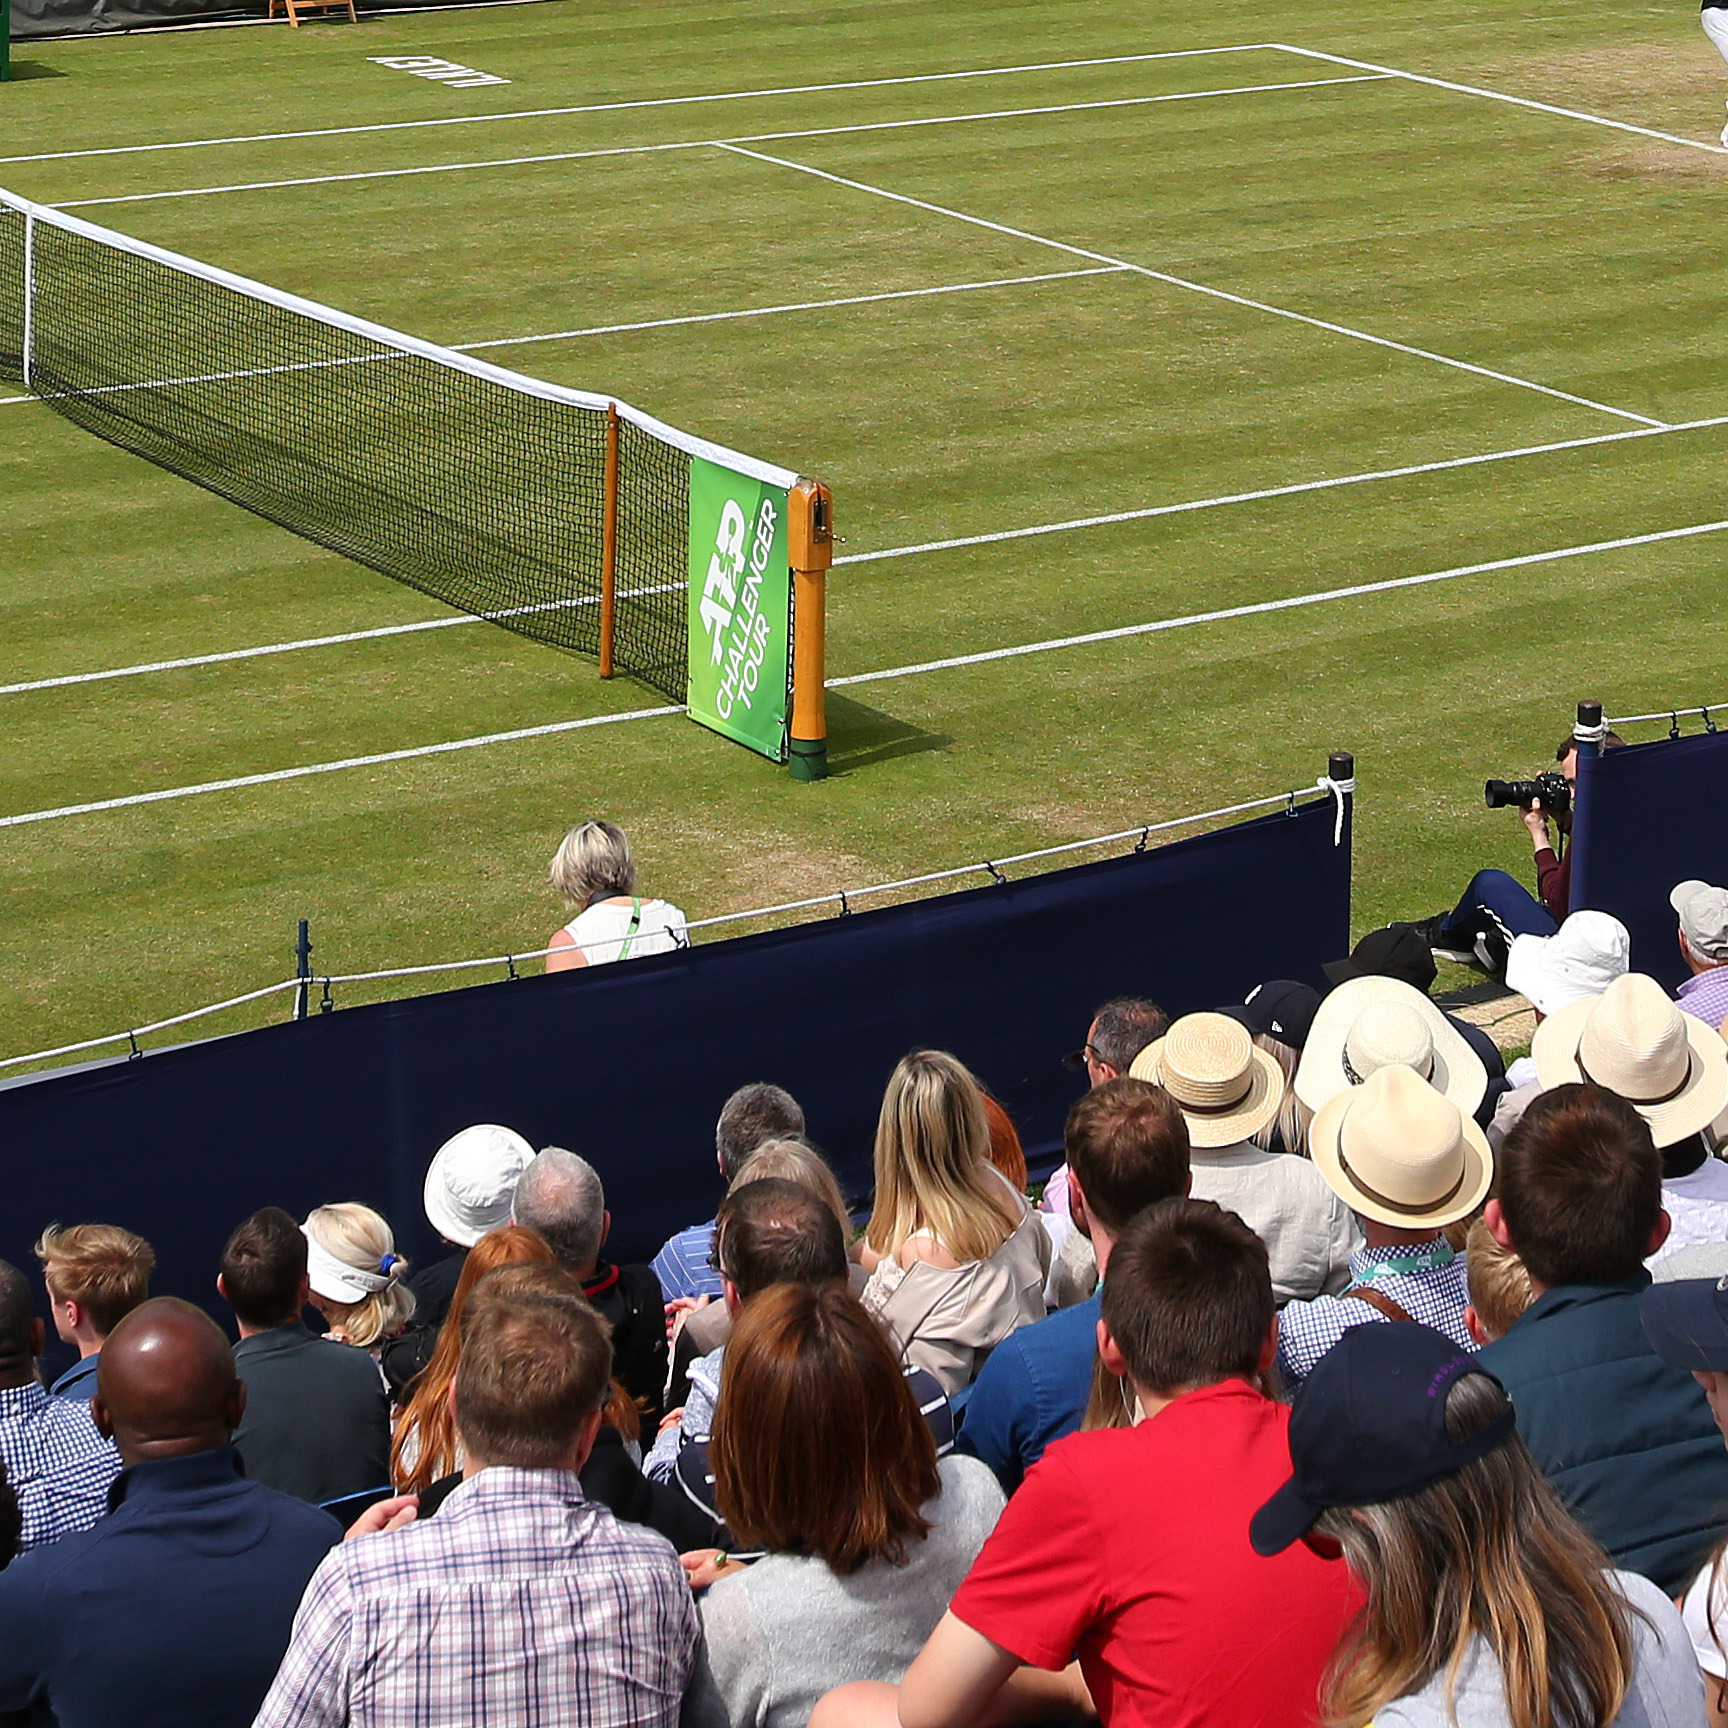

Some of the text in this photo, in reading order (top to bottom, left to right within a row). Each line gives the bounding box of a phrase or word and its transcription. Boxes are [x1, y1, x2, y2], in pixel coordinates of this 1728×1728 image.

[366, 55, 513, 88] ILKLEY
[699, 498, 747, 667] ATP
[716, 498, 778, 720] CHALLENGER
[736, 613, 771, 710] TOUR
